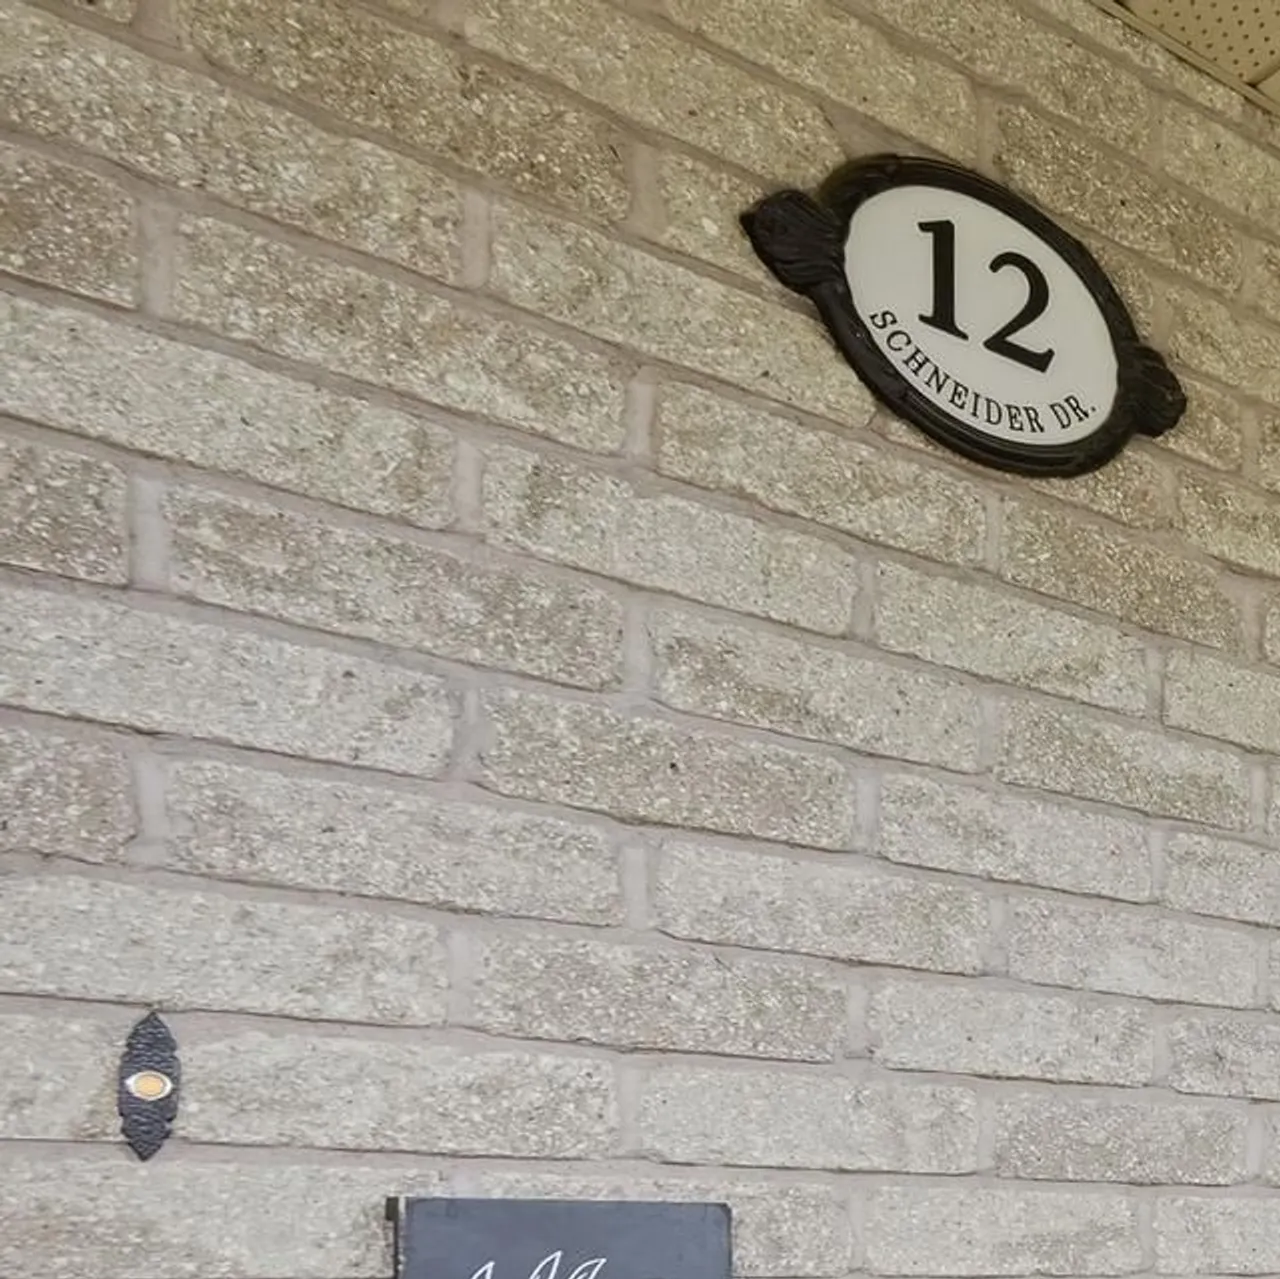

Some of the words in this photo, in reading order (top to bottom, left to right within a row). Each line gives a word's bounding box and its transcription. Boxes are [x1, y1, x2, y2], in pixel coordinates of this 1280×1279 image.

[917, 219, 1056, 374] 12
[869, 309, 1045, 434] SCHNEIDER
[1050, 394, 1097, 431] DR.
